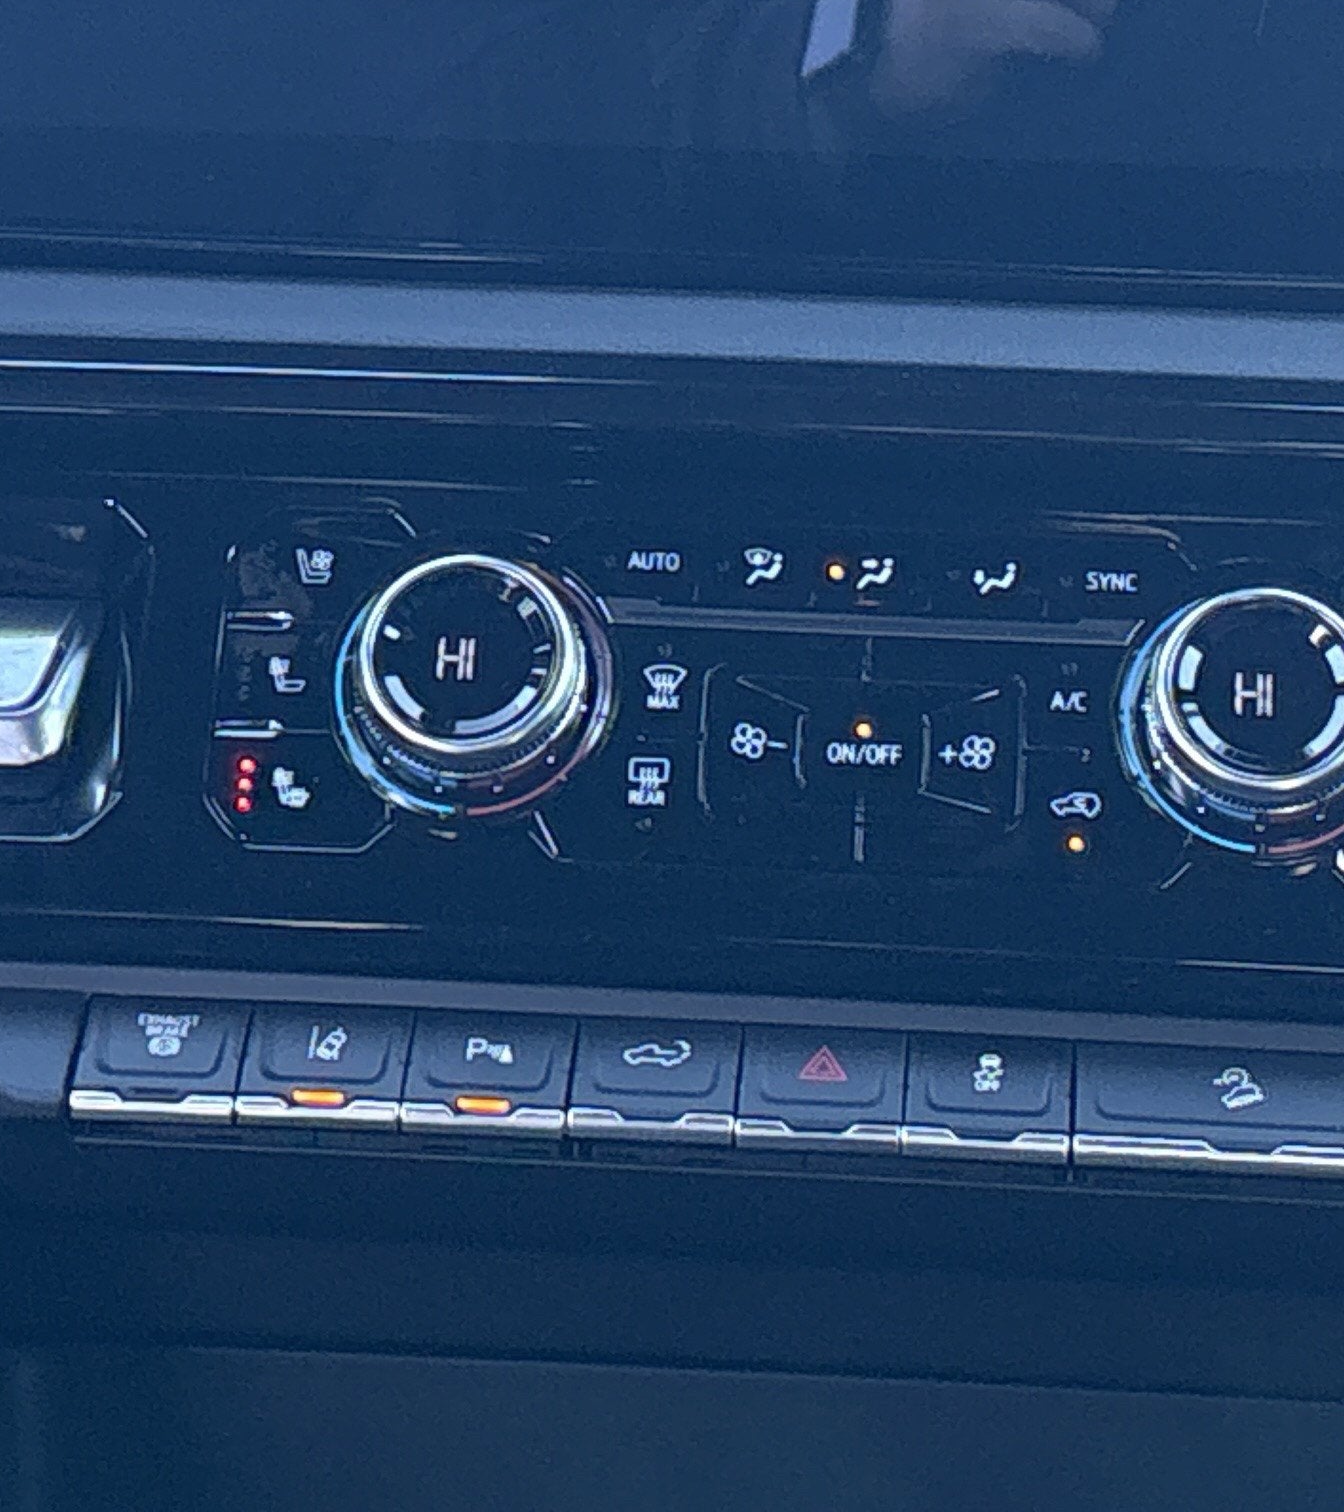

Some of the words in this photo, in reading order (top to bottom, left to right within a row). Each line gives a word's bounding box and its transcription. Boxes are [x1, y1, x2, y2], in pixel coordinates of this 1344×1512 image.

[627, 550, 681, 573] AUTO
[1085, 571, 1139, 592] SYNC
[436, 637, 476, 681] HI
[646, 694, 680, 710] MAX
[1049, 690, 1087, 713] A/C
[1234, 672, 1274, 717] HI
[826, 742, 903, 766] ON/OFF
[628, 789, 665, 806] REAR
